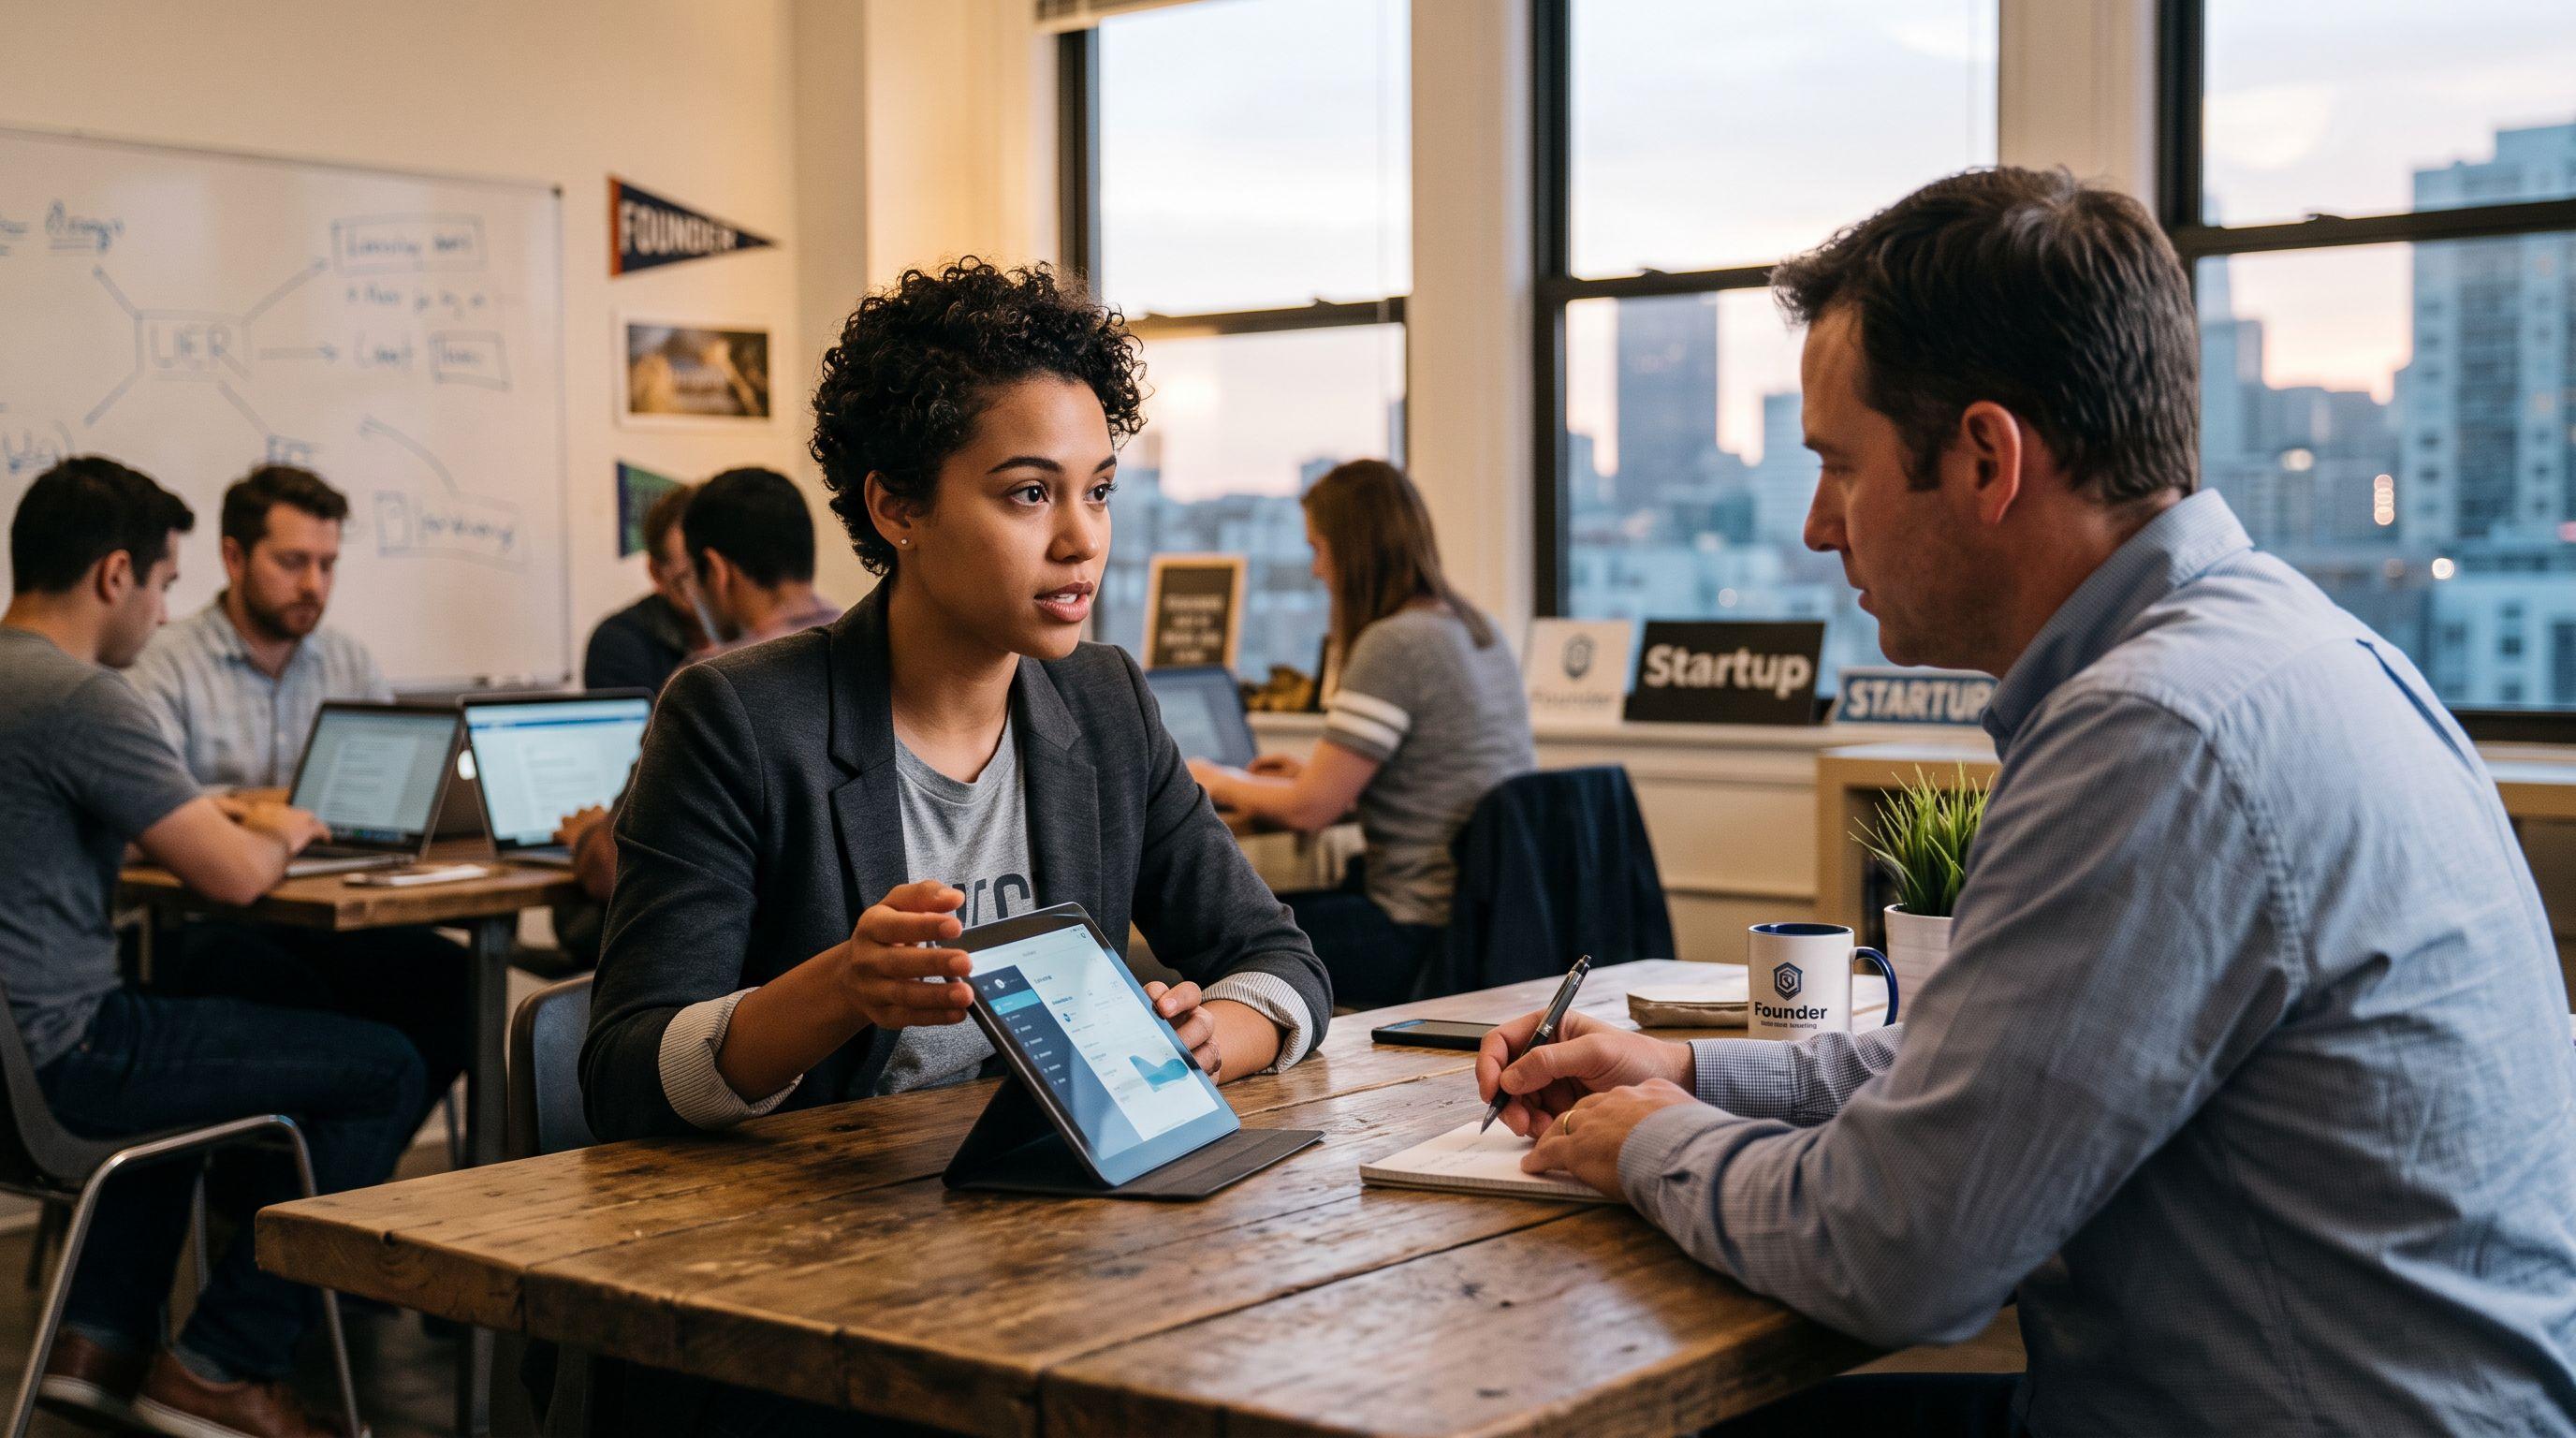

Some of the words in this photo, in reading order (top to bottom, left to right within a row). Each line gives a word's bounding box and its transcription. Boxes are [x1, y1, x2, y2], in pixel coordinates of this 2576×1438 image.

[620, 198, 738, 256] FOUNDER
[1645, 643, 1811, 699] Startup
[1848, 678, 1993, 722] STARTUP
[1754, 1002, 1827, 1020] Founder
